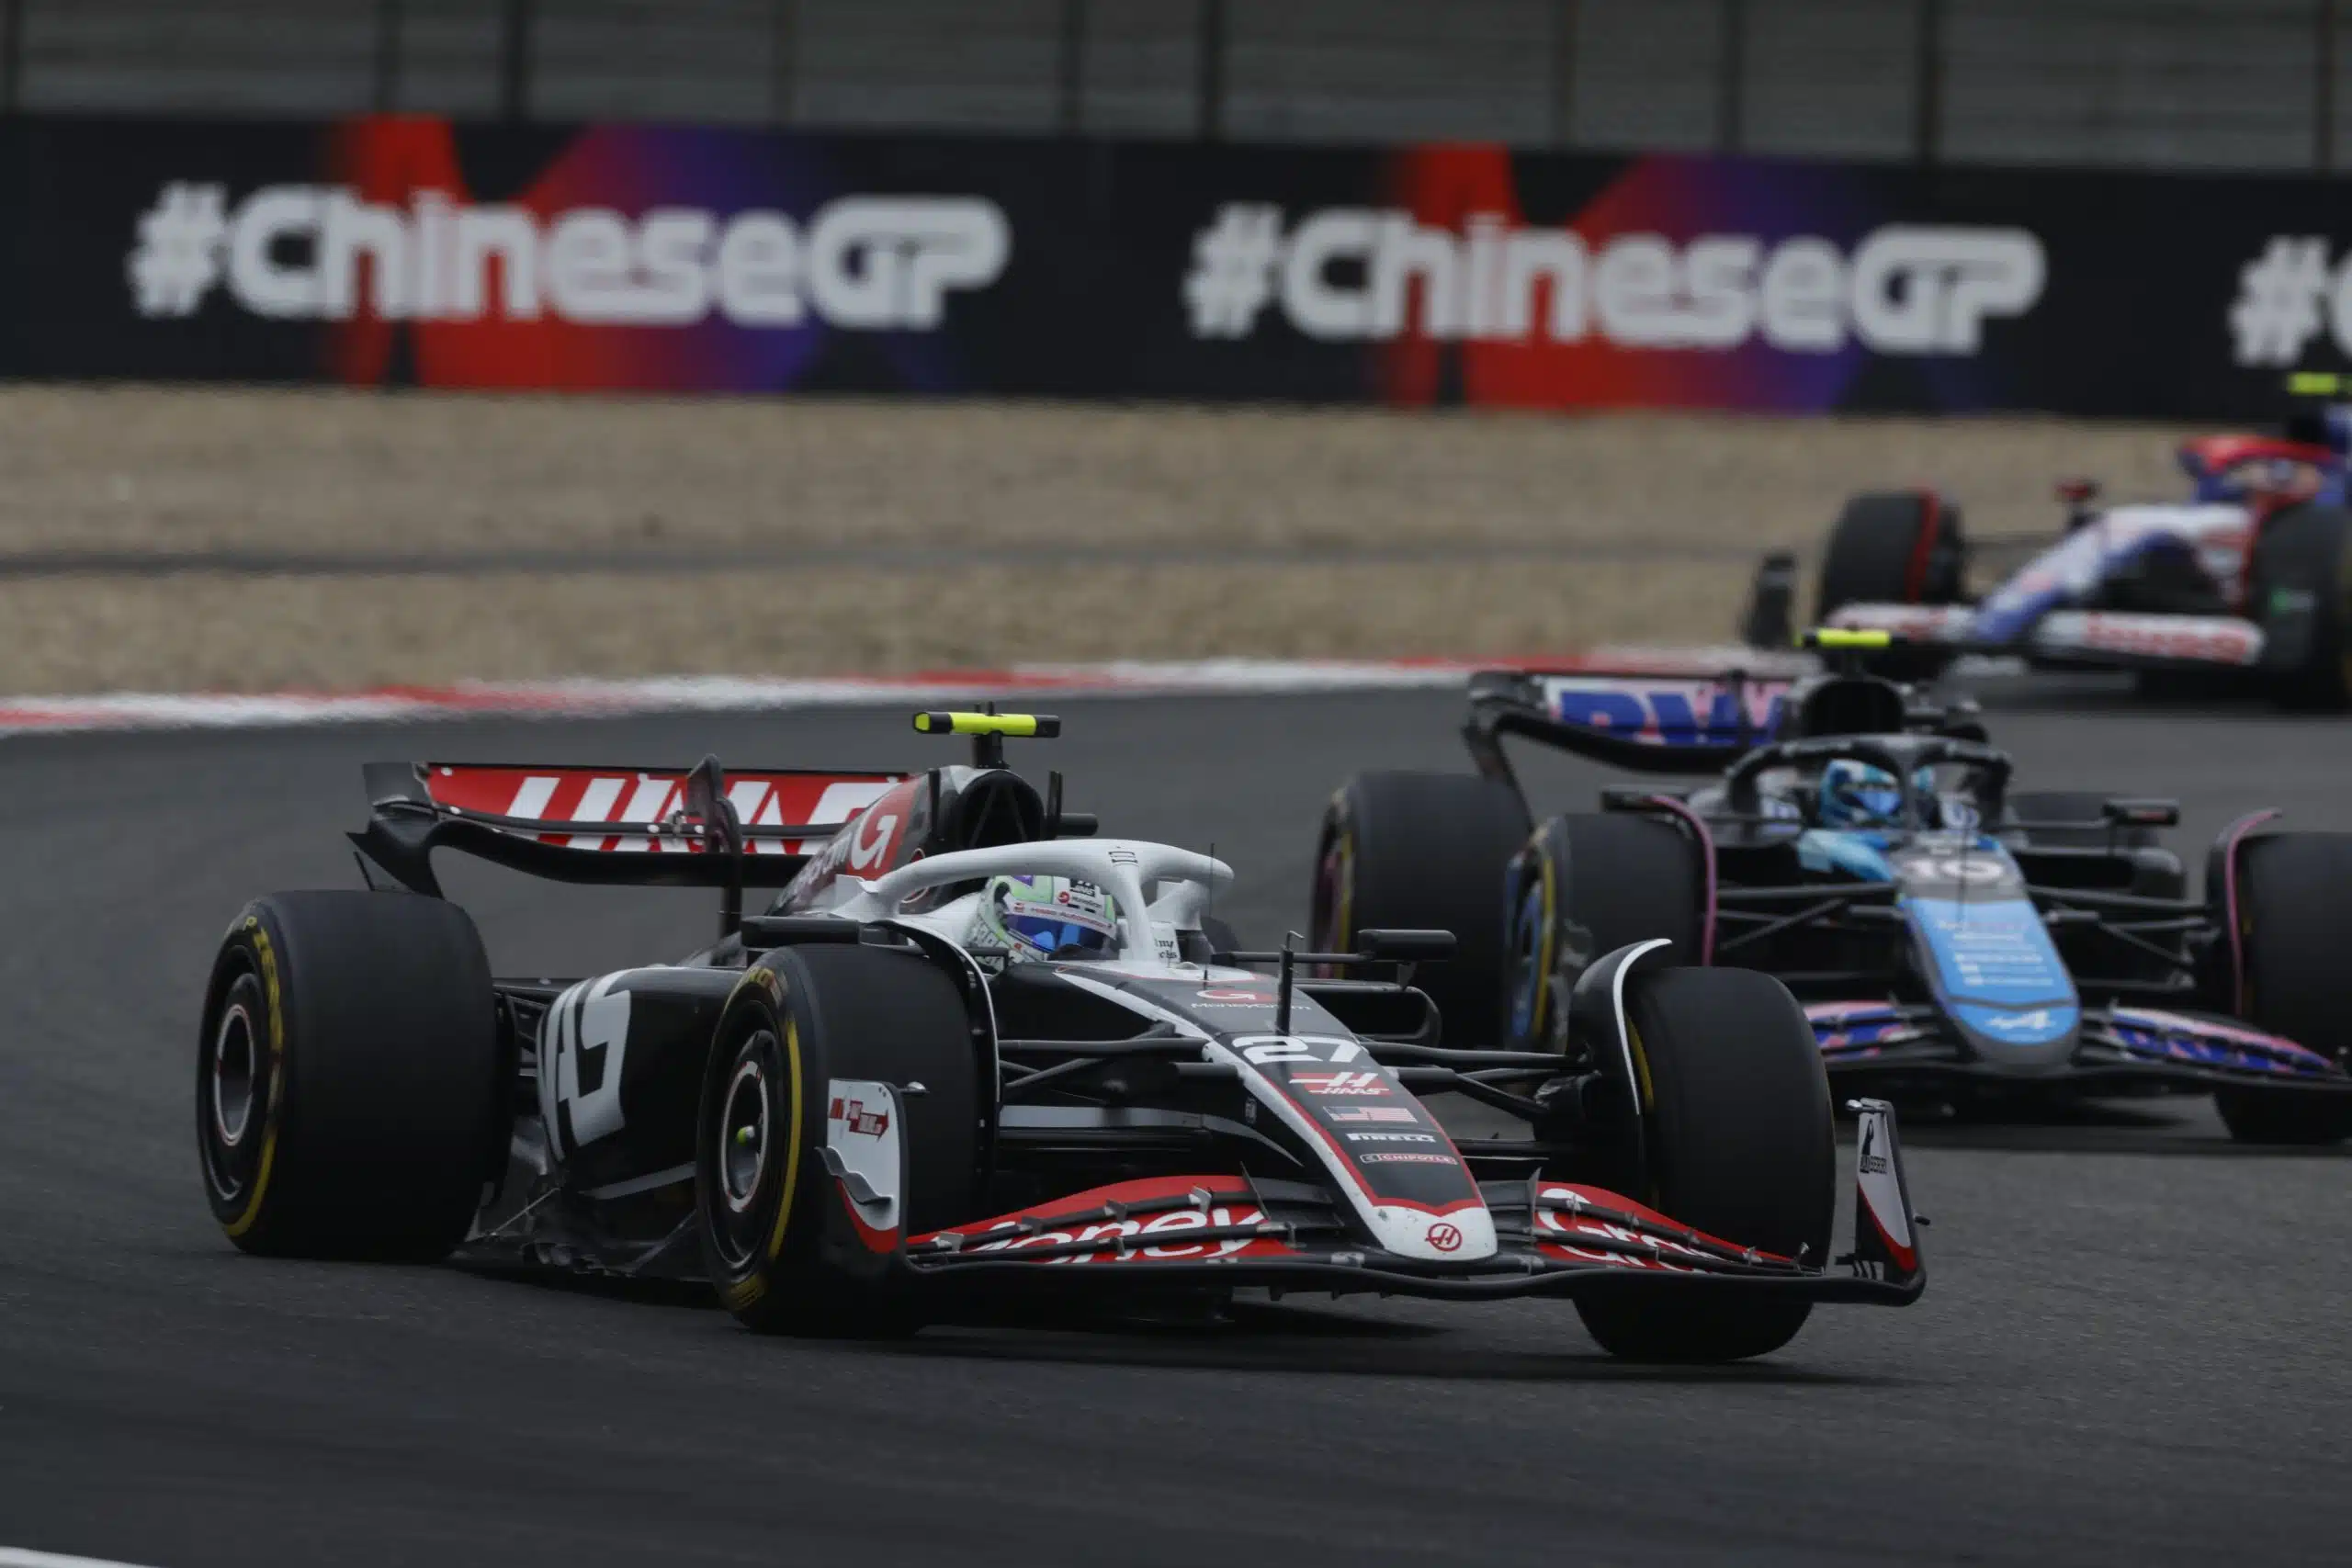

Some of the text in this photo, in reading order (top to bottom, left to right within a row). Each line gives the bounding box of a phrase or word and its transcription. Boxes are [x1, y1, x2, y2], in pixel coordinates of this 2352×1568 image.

[128, 182, 1012, 329] #ChineseGP
[1182, 202, 2048, 355] #ChineseGP
[1231, 1034, 1361, 1065] 27
